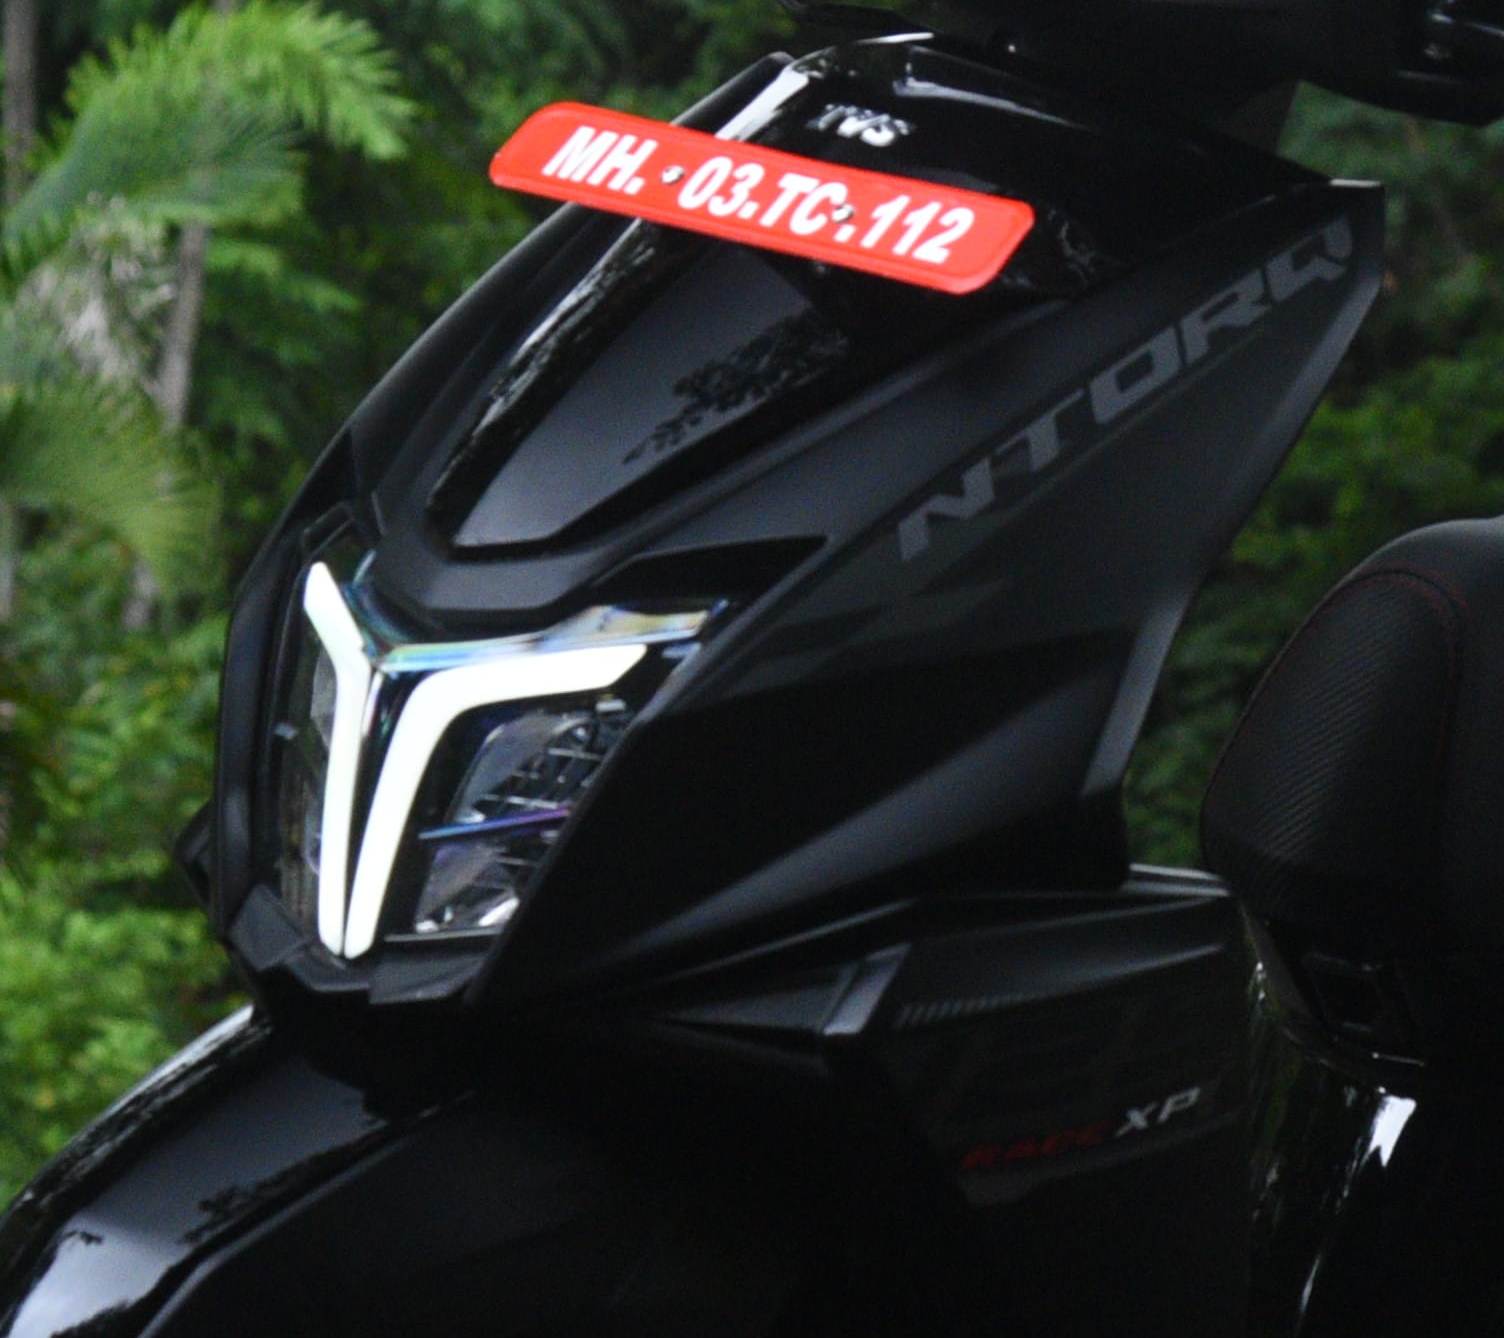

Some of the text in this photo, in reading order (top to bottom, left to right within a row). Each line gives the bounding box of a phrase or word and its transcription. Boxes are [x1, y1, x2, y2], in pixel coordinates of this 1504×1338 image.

[541, 125, 658, 196] MH.
[898, 214, 1354, 561] NTORQ
[1113, 1085, 1201, 1138] XP
